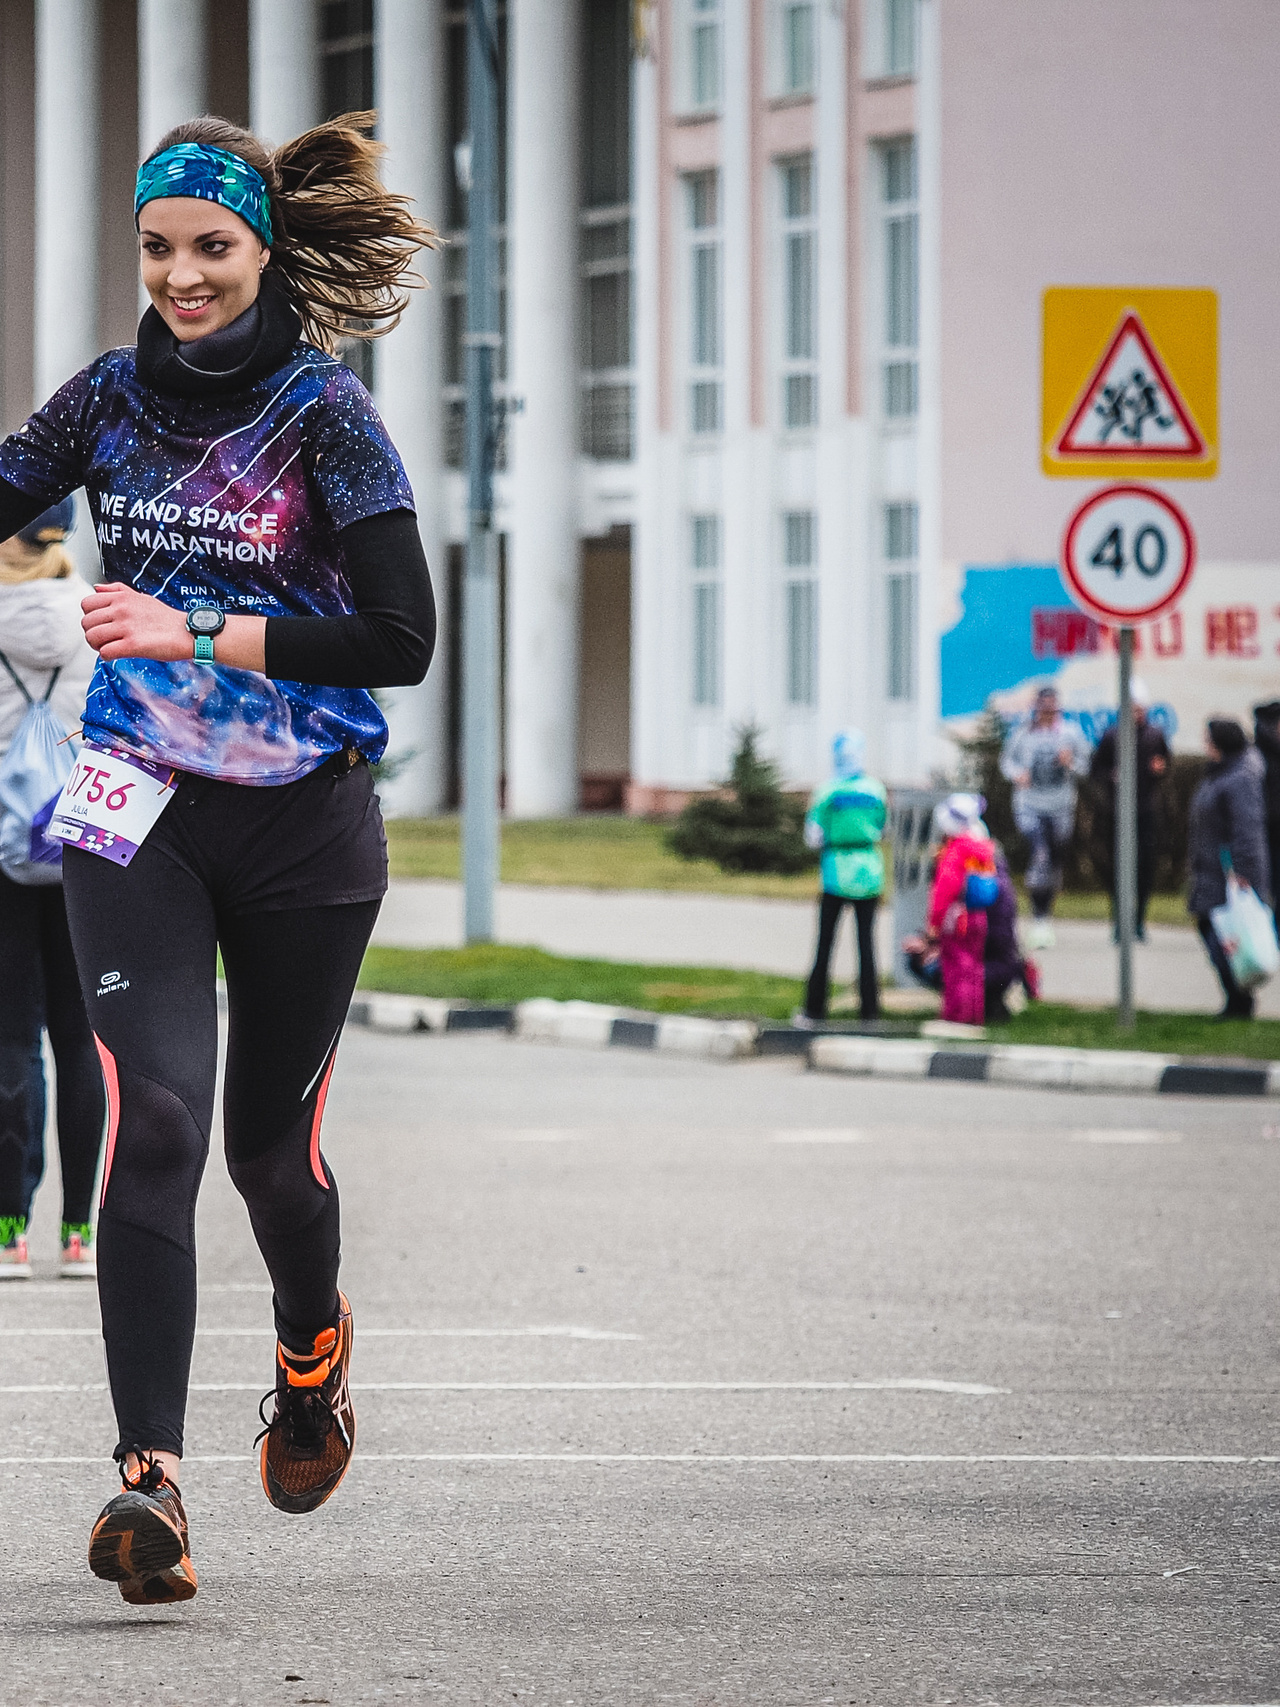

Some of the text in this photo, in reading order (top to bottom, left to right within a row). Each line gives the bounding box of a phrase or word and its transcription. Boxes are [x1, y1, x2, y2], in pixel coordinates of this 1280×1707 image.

[128, 498, 182, 524] AND
[186, 506, 278, 535] SPACE
[97, 521, 277, 566] ALF MARATHON
[1090, 524, 1168, 577] 40
[180, 585, 208, 596] RUN
[66, 762, 137, 811] 0756
[71, 804, 89, 817] JULIA
